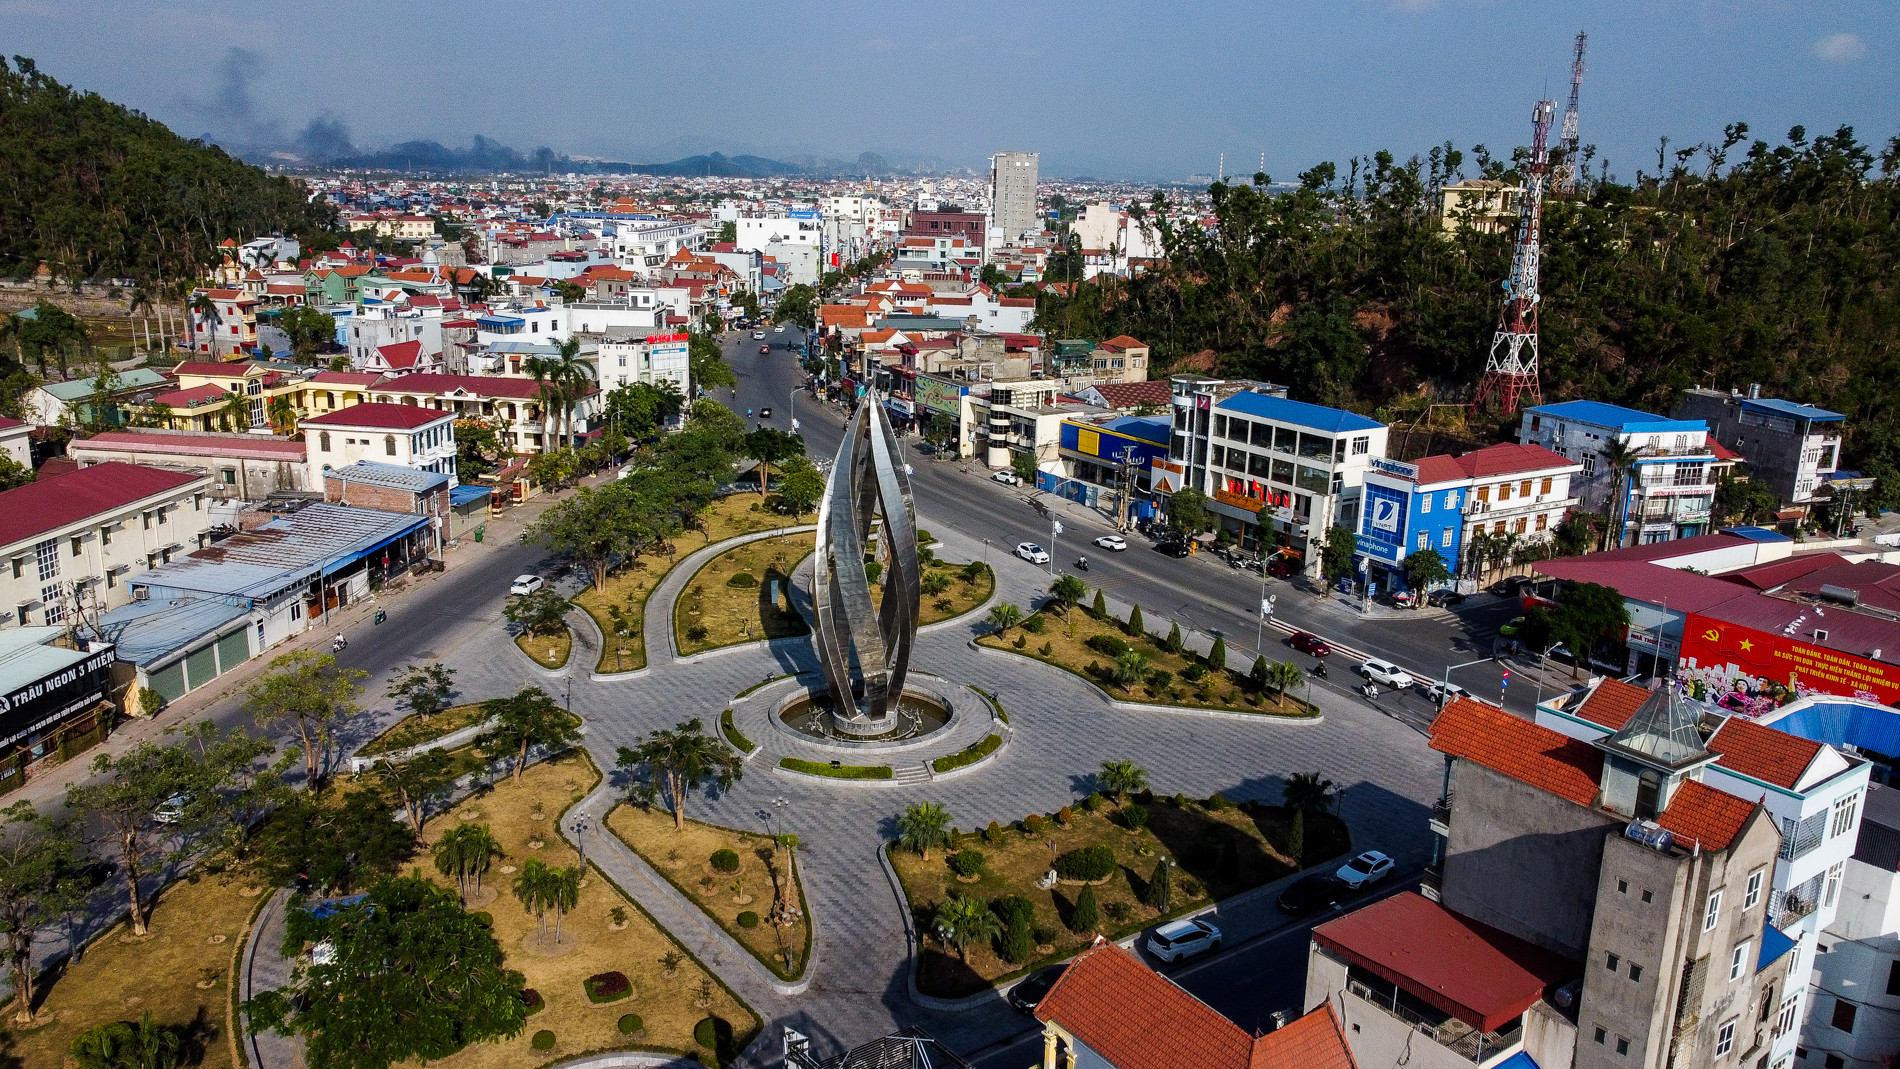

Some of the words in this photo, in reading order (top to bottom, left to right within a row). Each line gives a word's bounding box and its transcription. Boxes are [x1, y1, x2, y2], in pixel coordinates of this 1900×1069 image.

[1357, 538, 1388, 554] vinaphone
[1774, 650, 1781, 658] RA
[1794, 655, 1802, 663] THI
[1792, 646, 1806, 655] TOÀN
[1823, 653, 1838, 663] TOÀN
[1853, 661, 1867, 671] TOÀN
[1868, 664, 1884, 676] QUÂN
[12, 684, 43, 707] TRÂU
[45, 668, 76, 692] NGON
[79, 665, 85, 677] 3
[87, 651, 114, 673] MIỀN
[1826, 673, 1839, 682] KINH
